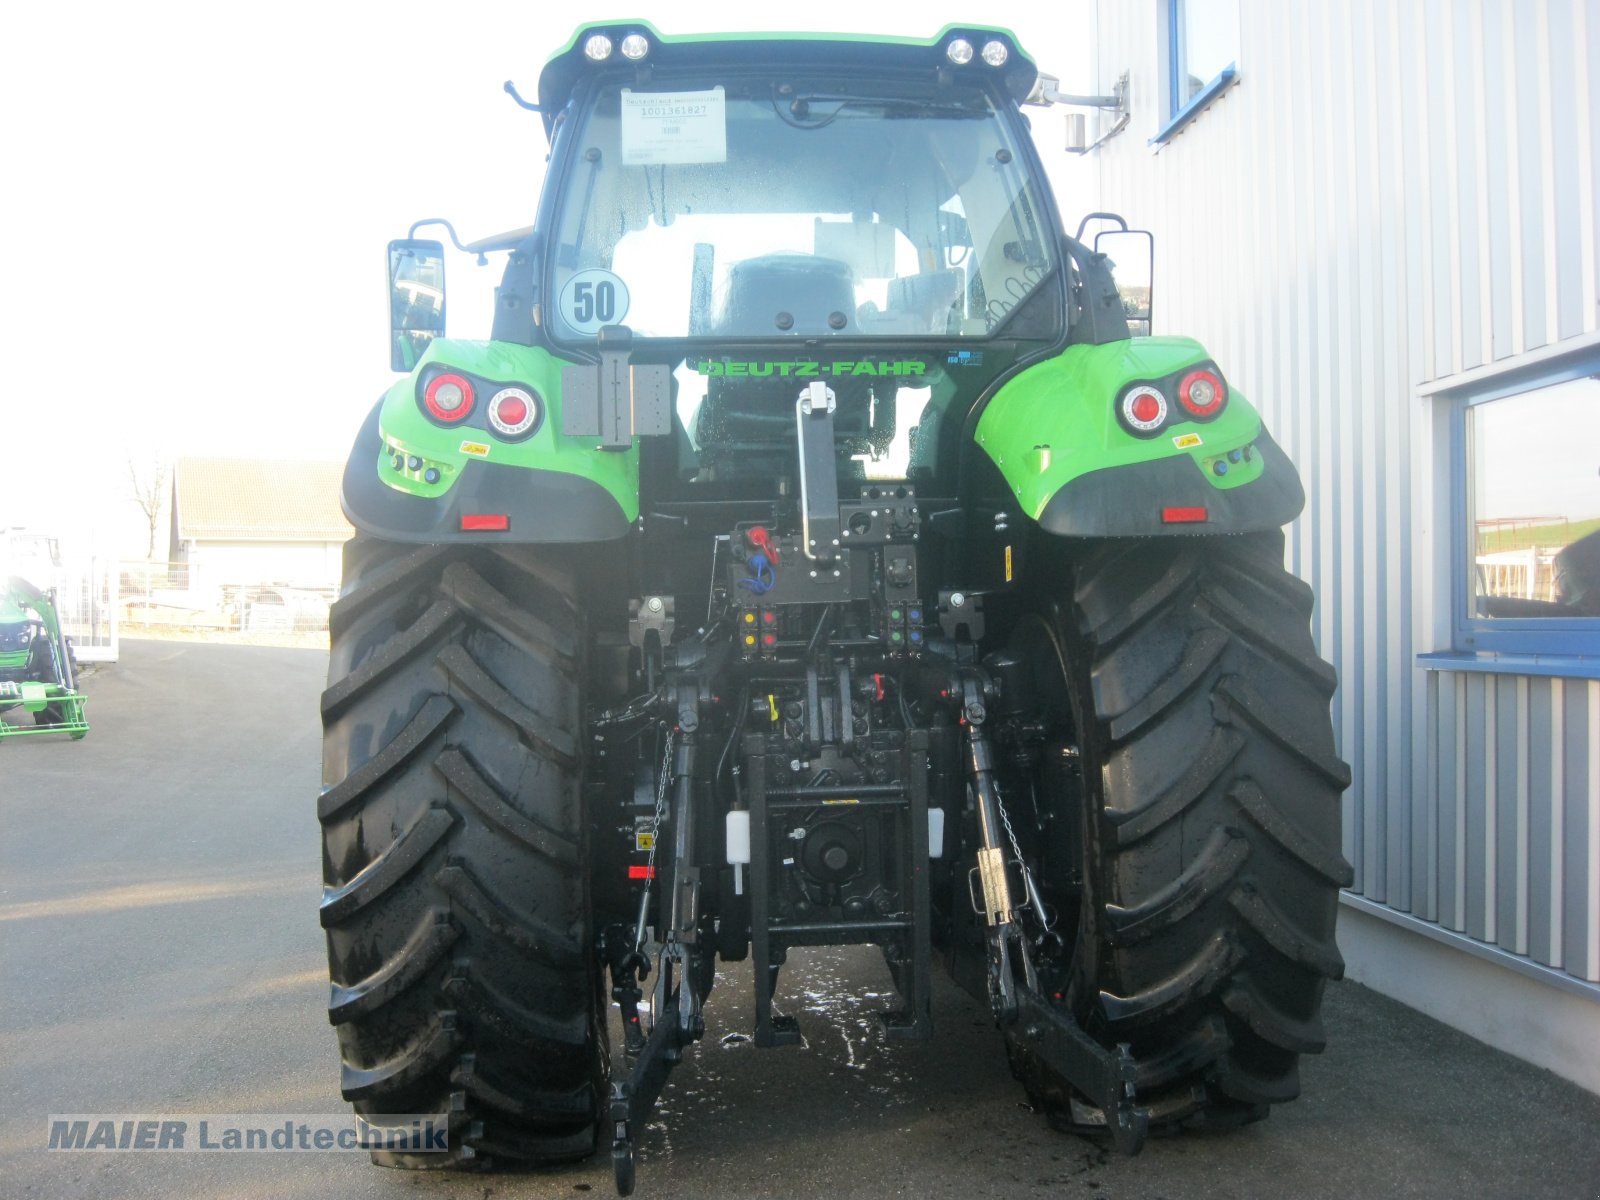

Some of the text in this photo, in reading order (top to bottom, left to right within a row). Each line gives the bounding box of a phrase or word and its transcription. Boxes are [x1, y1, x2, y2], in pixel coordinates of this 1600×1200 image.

[641, 105, 707, 116] 1001361827
[574, 280, 615, 323] 50
[698, 361, 925, 376] DEUTZ-FAHR
